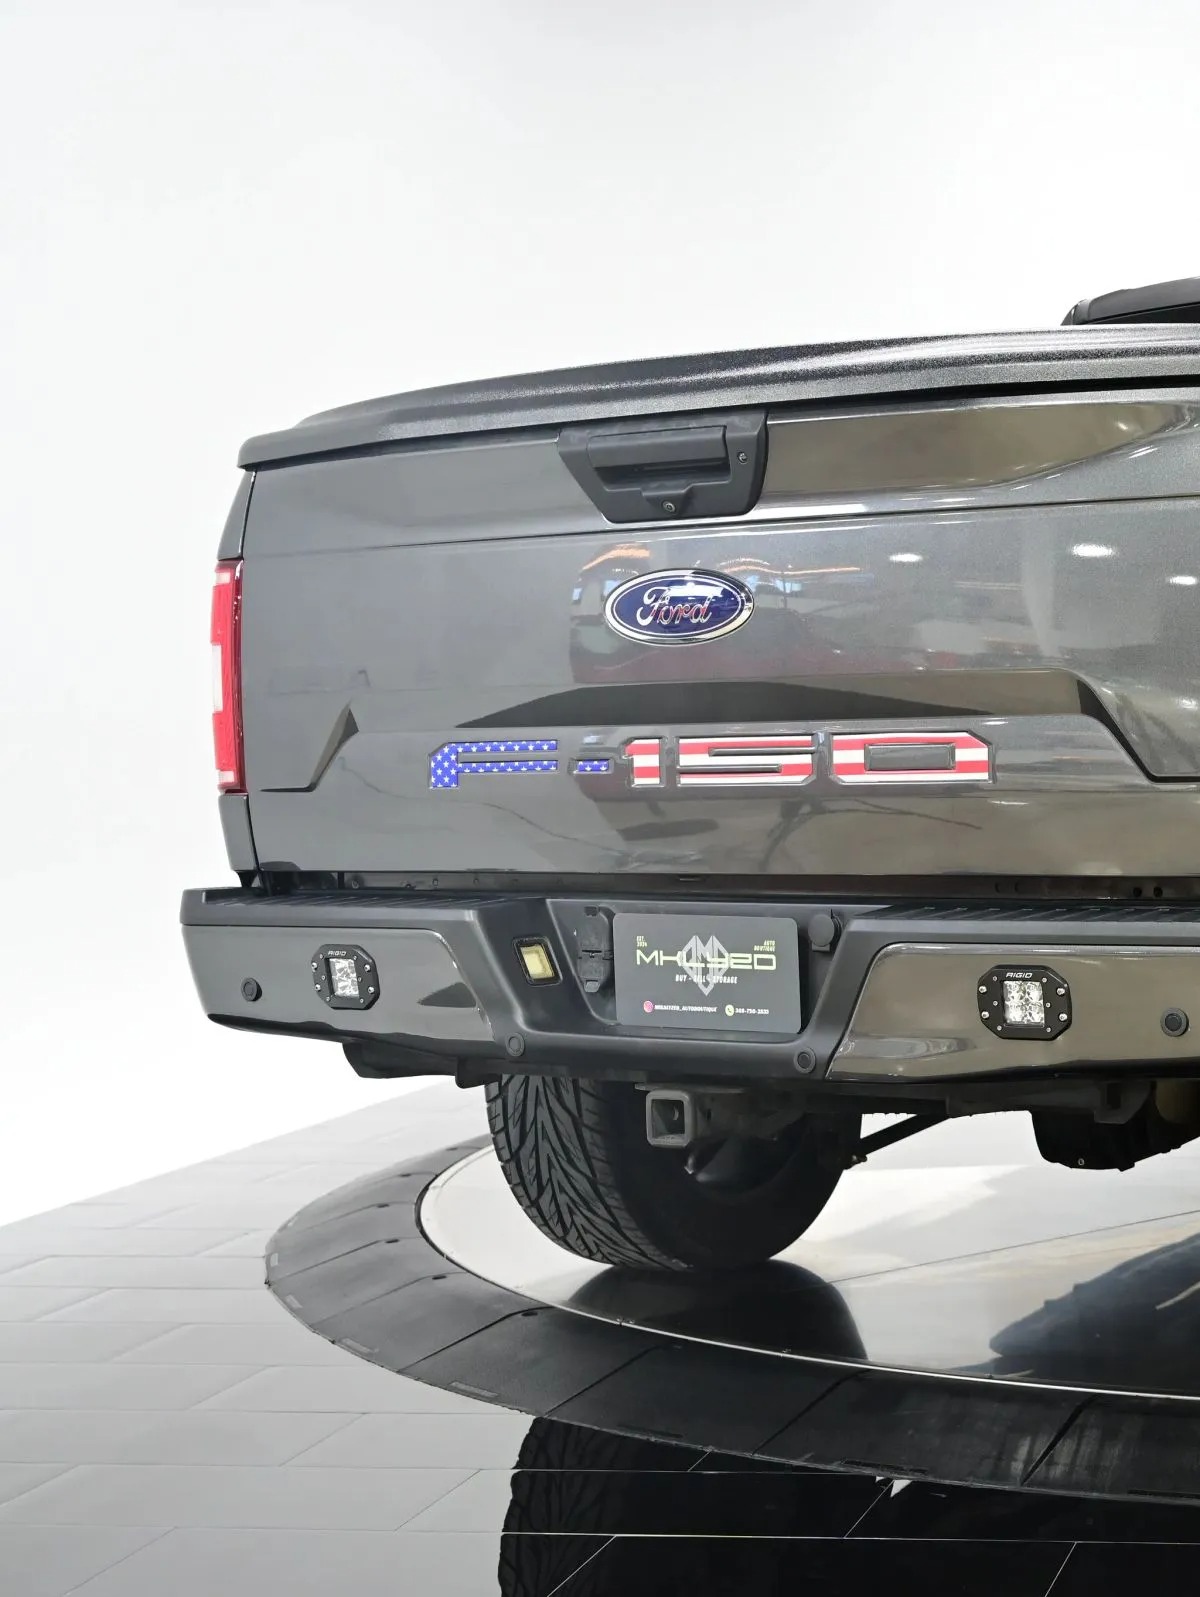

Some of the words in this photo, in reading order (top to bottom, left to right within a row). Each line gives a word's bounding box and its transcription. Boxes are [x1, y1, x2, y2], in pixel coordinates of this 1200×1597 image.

[636, 585, 713, 626] Ford
[430, 731, 993, 788] F-150
[675, 974, 688, 982] BUY
